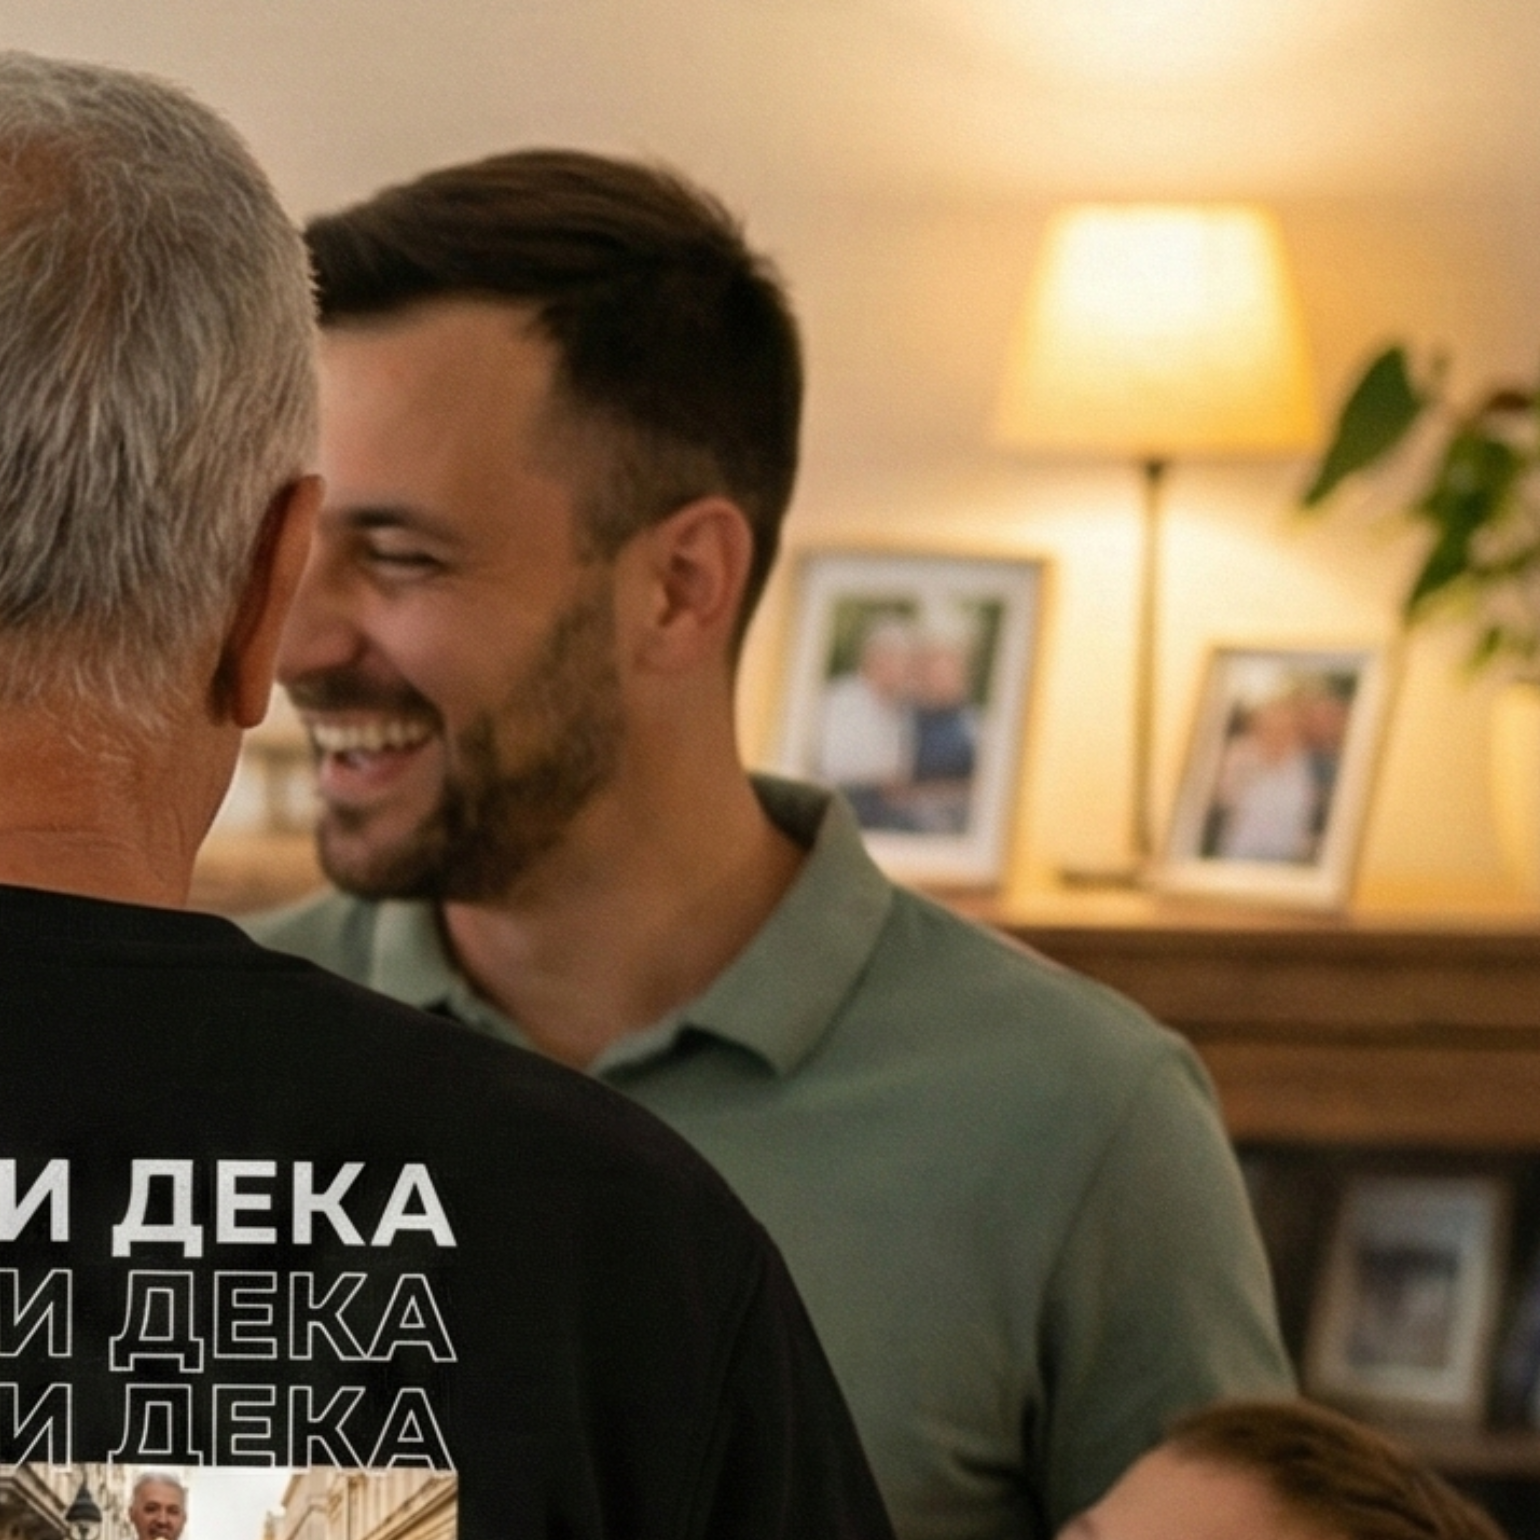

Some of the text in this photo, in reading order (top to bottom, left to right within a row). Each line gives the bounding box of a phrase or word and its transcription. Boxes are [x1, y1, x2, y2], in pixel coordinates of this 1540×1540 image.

[111, 1158, 457, 1258] ДЕКА
[109, 1270, 458, 1373] ДЕКА
[109, 1383, 458, 1474] ДЕКА
